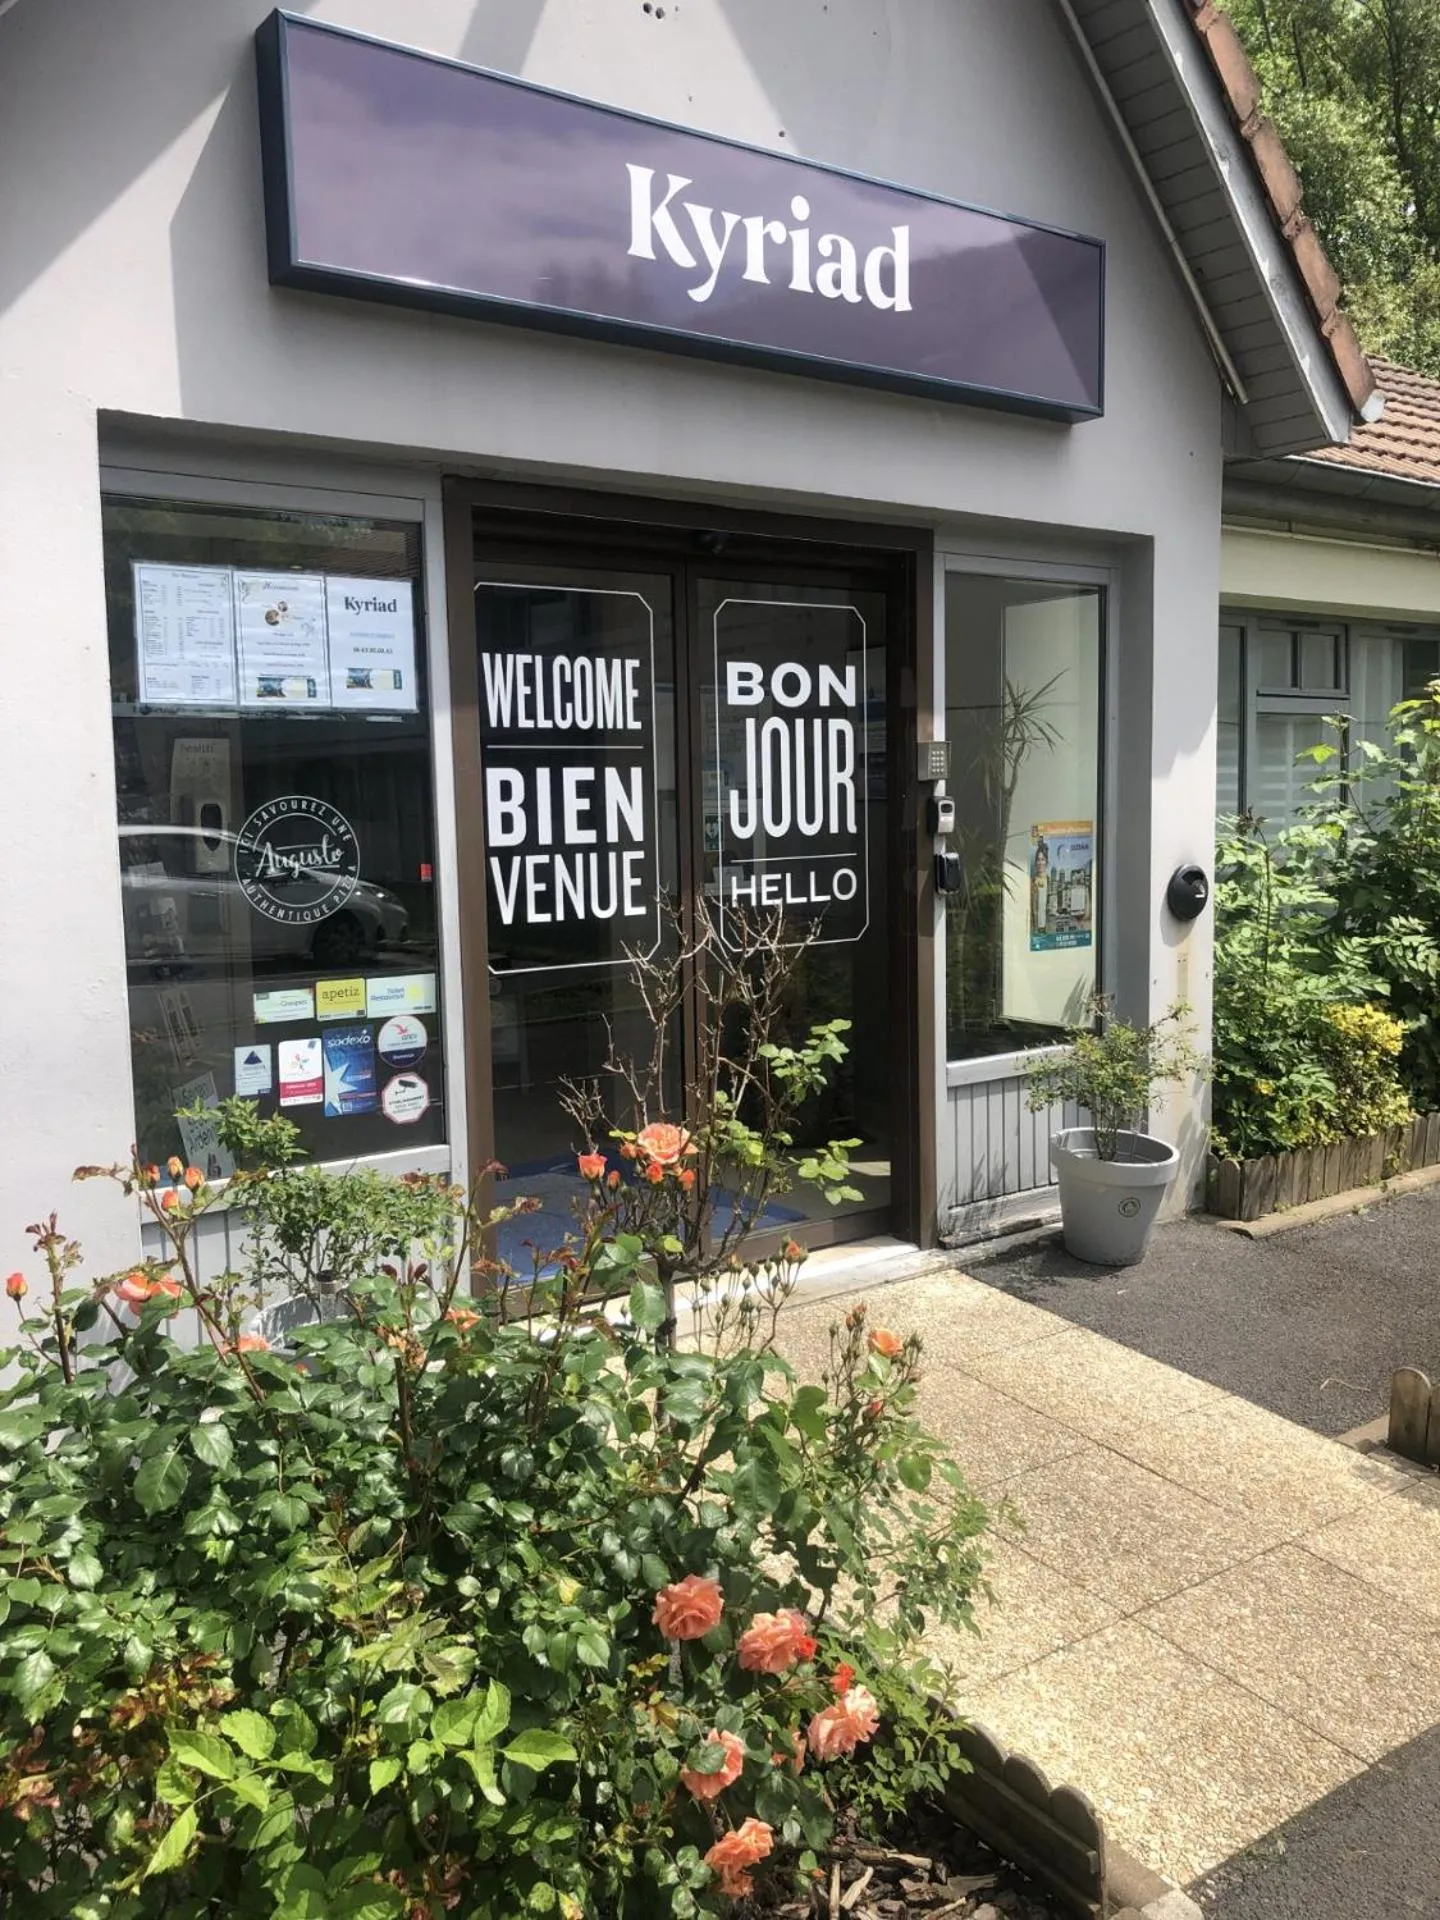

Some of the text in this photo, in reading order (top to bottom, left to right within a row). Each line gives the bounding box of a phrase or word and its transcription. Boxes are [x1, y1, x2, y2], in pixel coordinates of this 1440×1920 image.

[626, 163, 913, 312] Kyriad
[344, 596, 397, 616] Kyriad
[482, 653, 642, 730] WELCOME
[727, 661, 856, 708] BON
[729, 716, 857, 840] JOUR
[253, 800, 327, 826] SAVOUREZ
[332, 816, 352, 841] UNE
[486, 766, 644, 847] BIEN
[255, 834, 345, 879] Auguste
[242, 879, 330, 921] AUTHENTIQUE
[489, 850, 647, 925] VENUE
[731, 868, 857, 907] HELLO
[322, 986, 360, 1001] apetiz
[327, 1031, 371, 1048] sodexo
